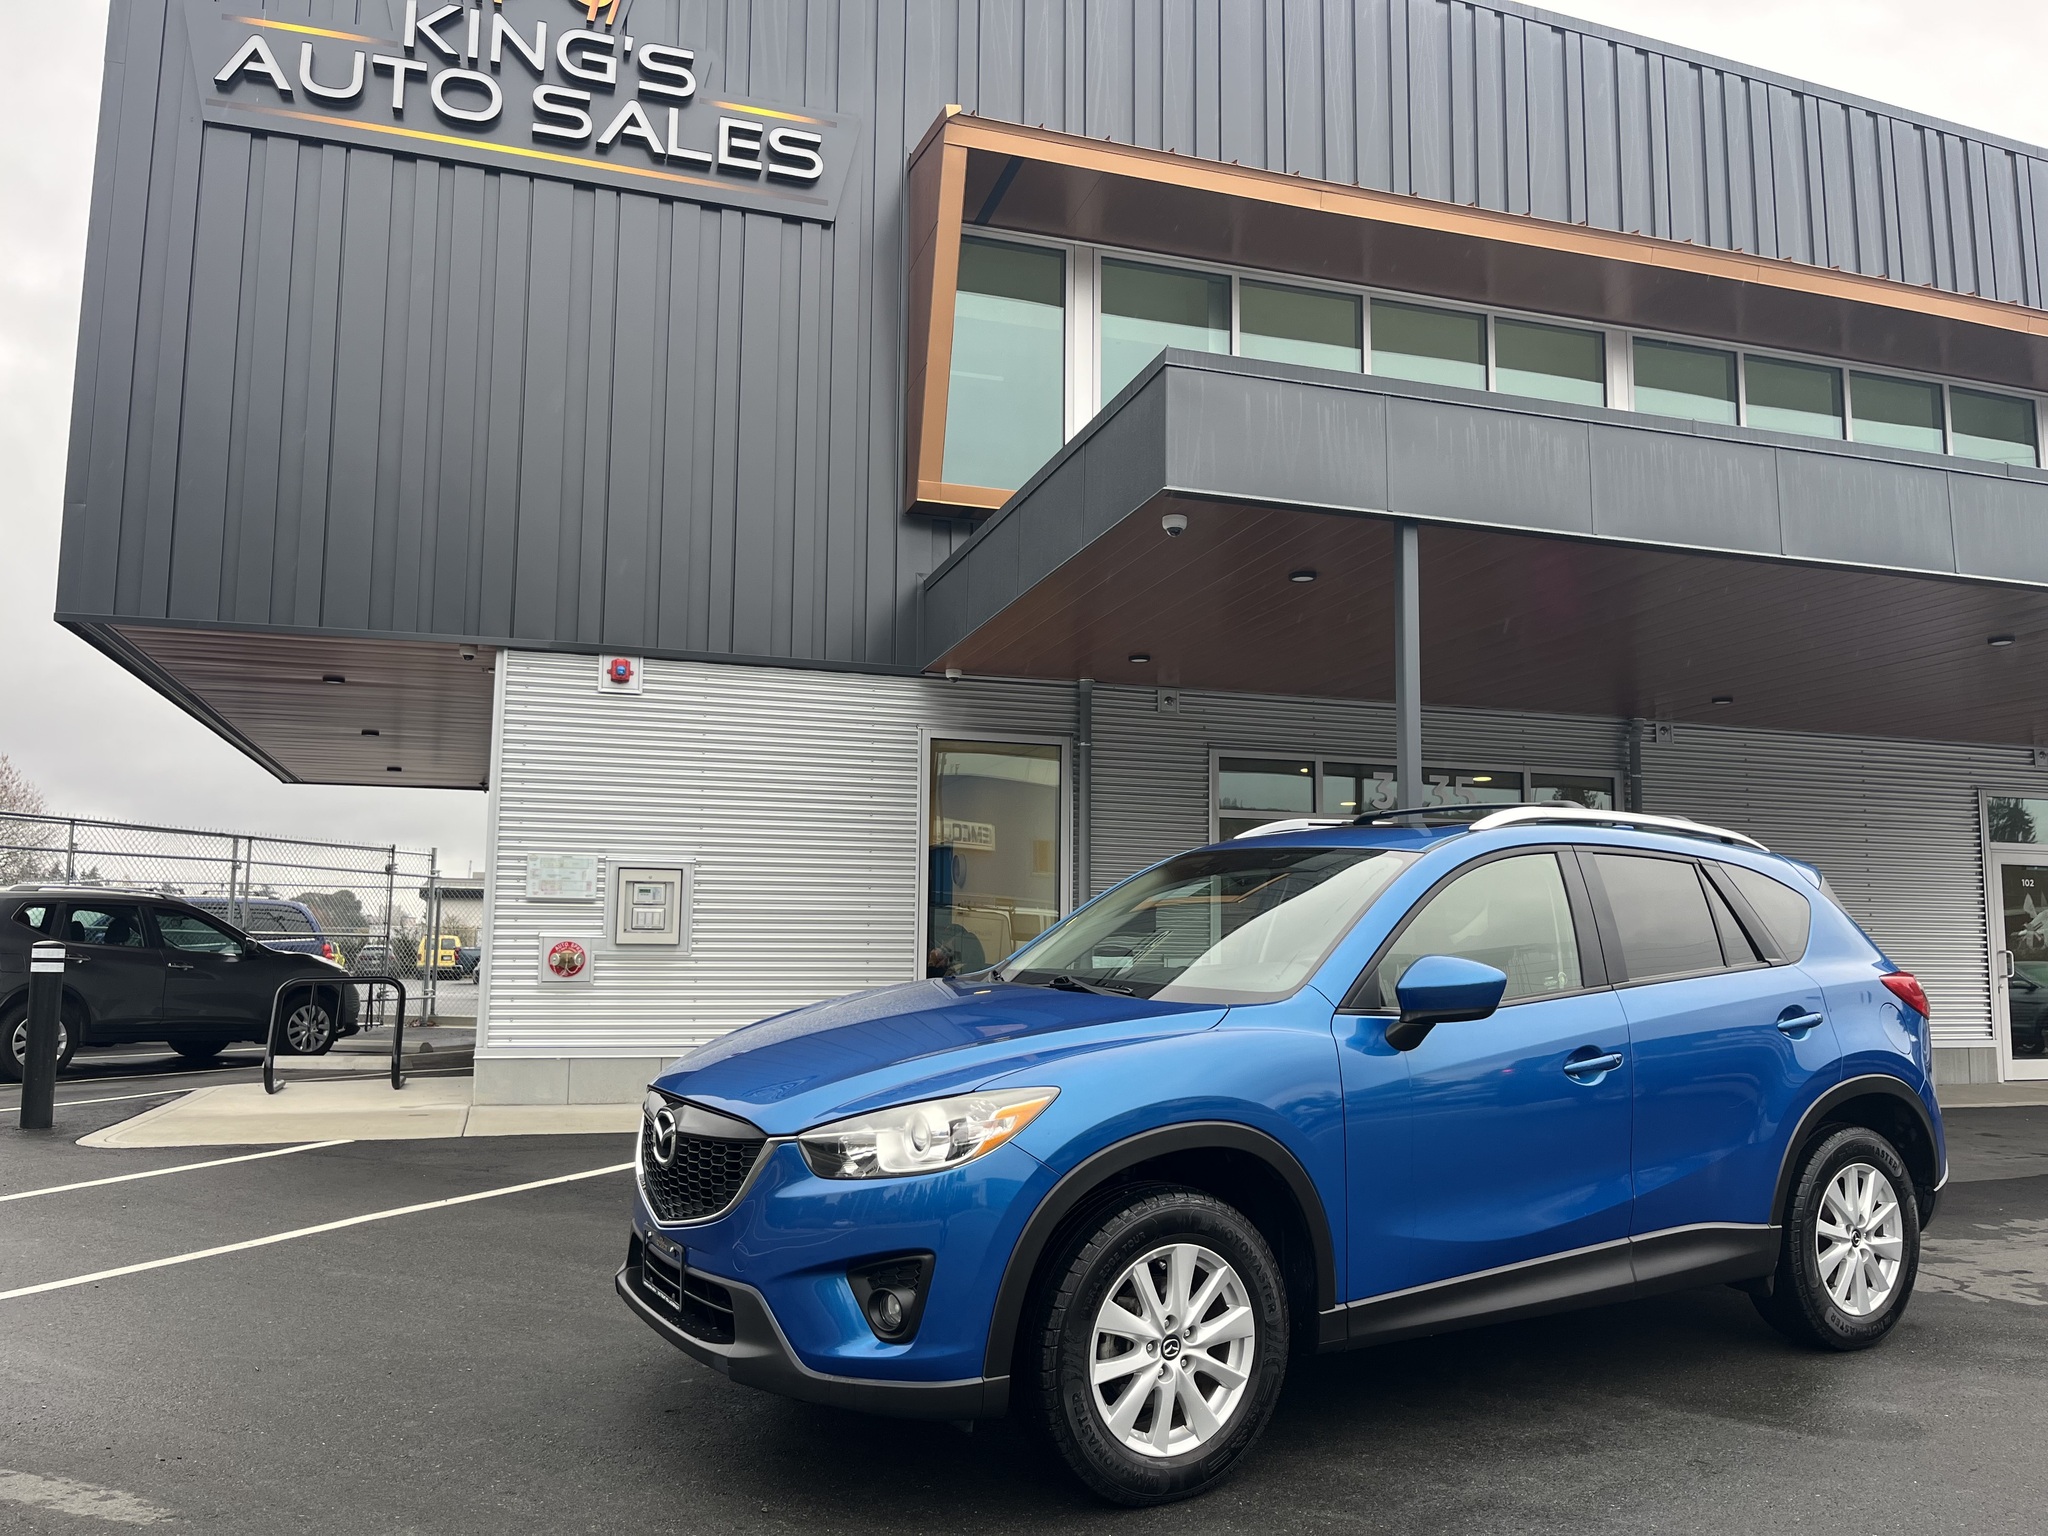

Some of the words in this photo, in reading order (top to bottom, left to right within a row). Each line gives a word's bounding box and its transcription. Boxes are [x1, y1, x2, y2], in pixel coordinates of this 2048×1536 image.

[403, 0, 698, 99] KING'S
[213, 33, 504, 124] AUTO
[531, 83, 825, 182] SALES
[2021, 879, 2034, 887] 102
[555, 942, 569, 951] AUTO
[1121, 1231, 1147, 1253] TOUR
